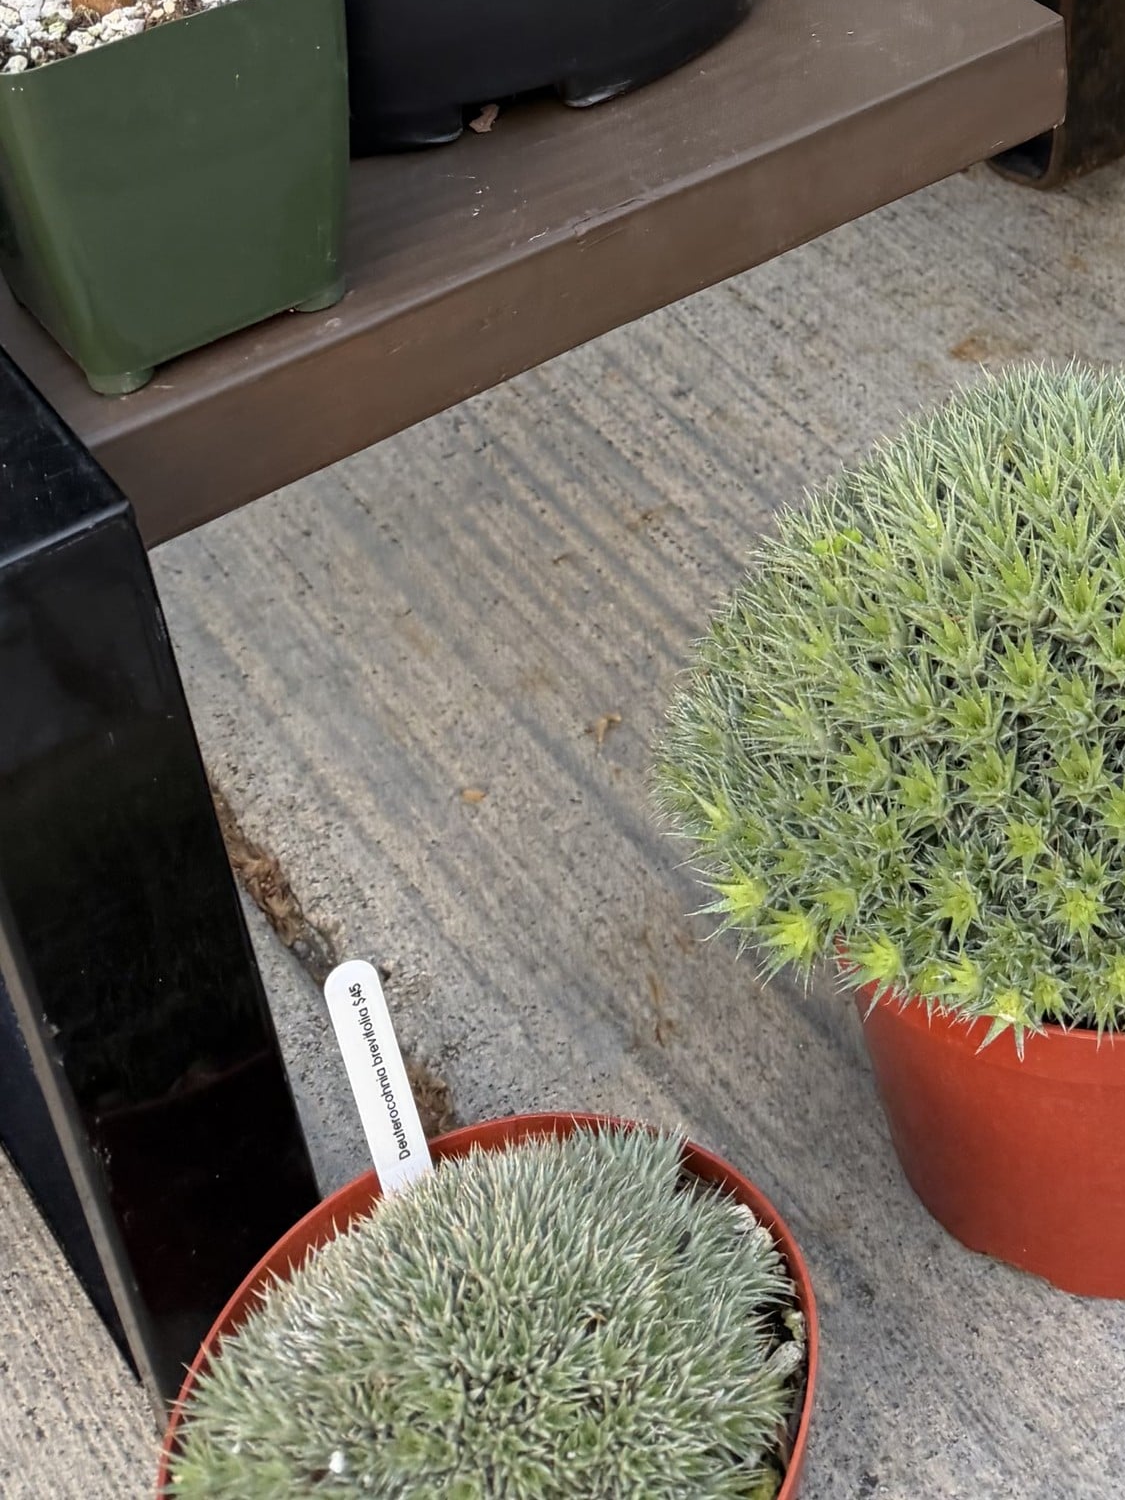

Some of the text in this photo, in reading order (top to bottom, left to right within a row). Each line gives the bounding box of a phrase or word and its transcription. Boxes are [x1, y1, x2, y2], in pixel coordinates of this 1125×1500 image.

[348, 982, 411, 1161] Deuterocohnia brevifolia $45
